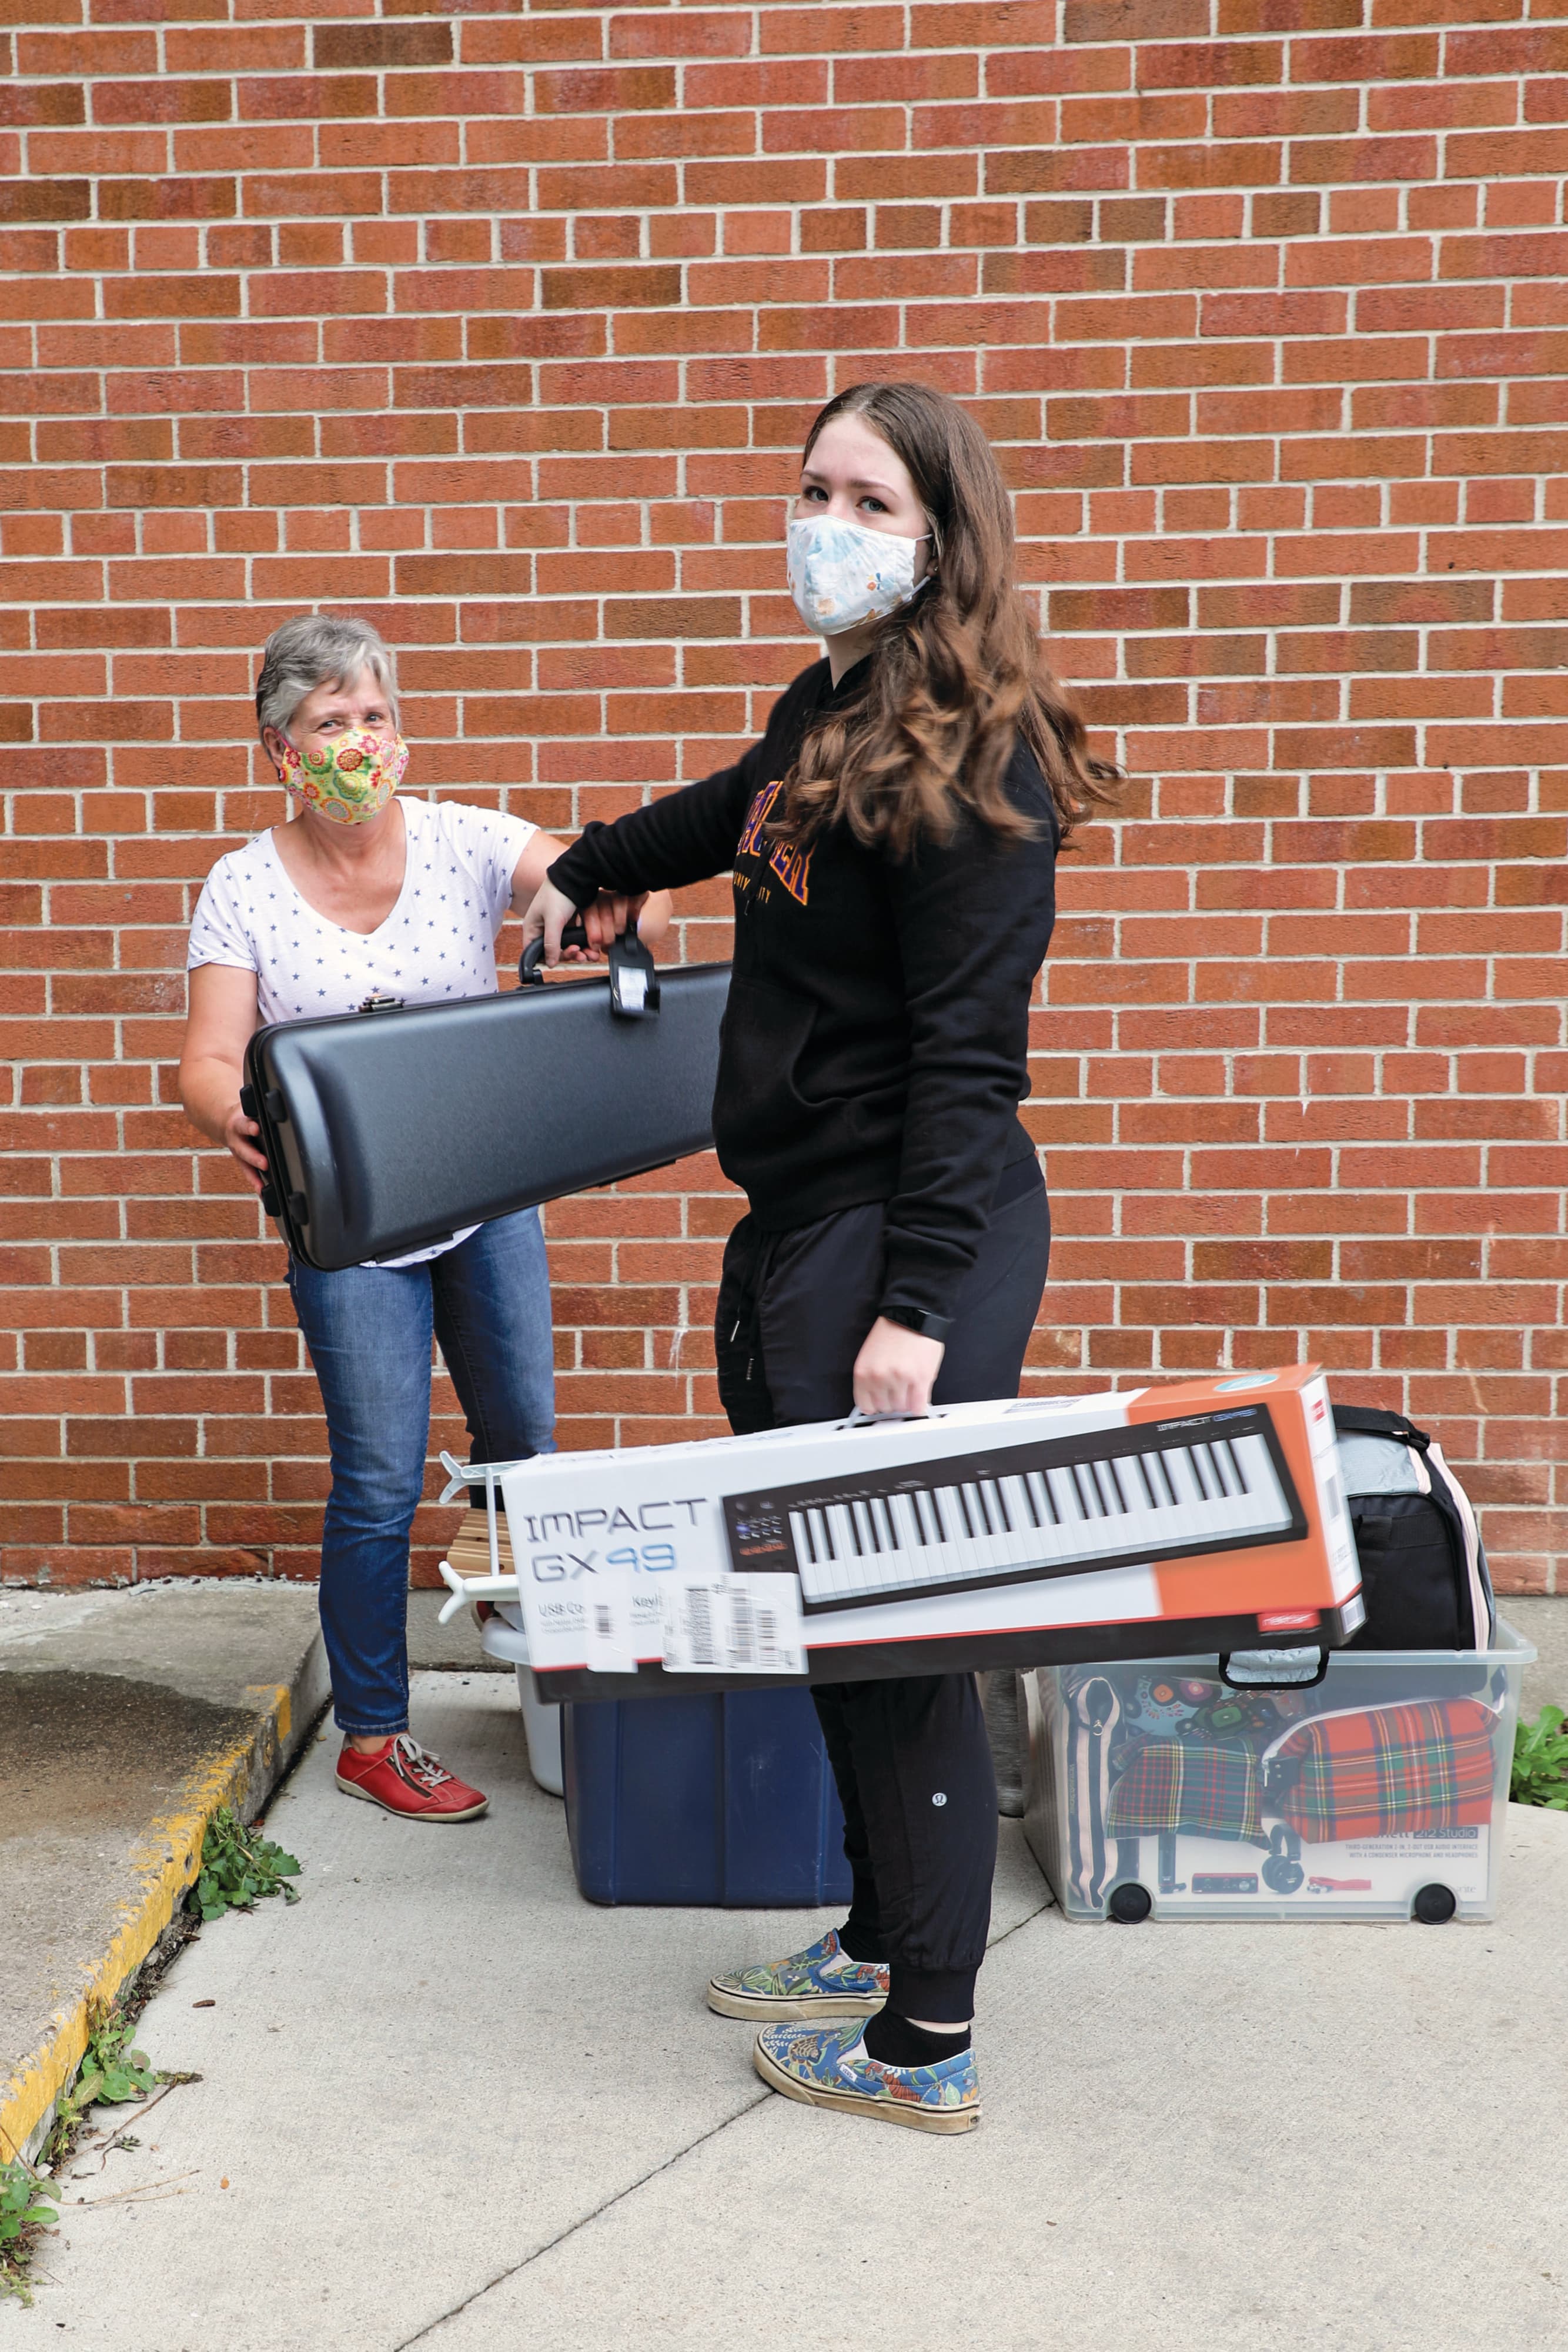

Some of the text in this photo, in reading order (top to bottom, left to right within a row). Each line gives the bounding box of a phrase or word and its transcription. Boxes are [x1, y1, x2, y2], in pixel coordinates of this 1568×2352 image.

[523, 1498, 707, 1542] IMPACT
[531, 1544, 676, 1582] GX49
[1439, 1827, 1476, 1838] Studio
